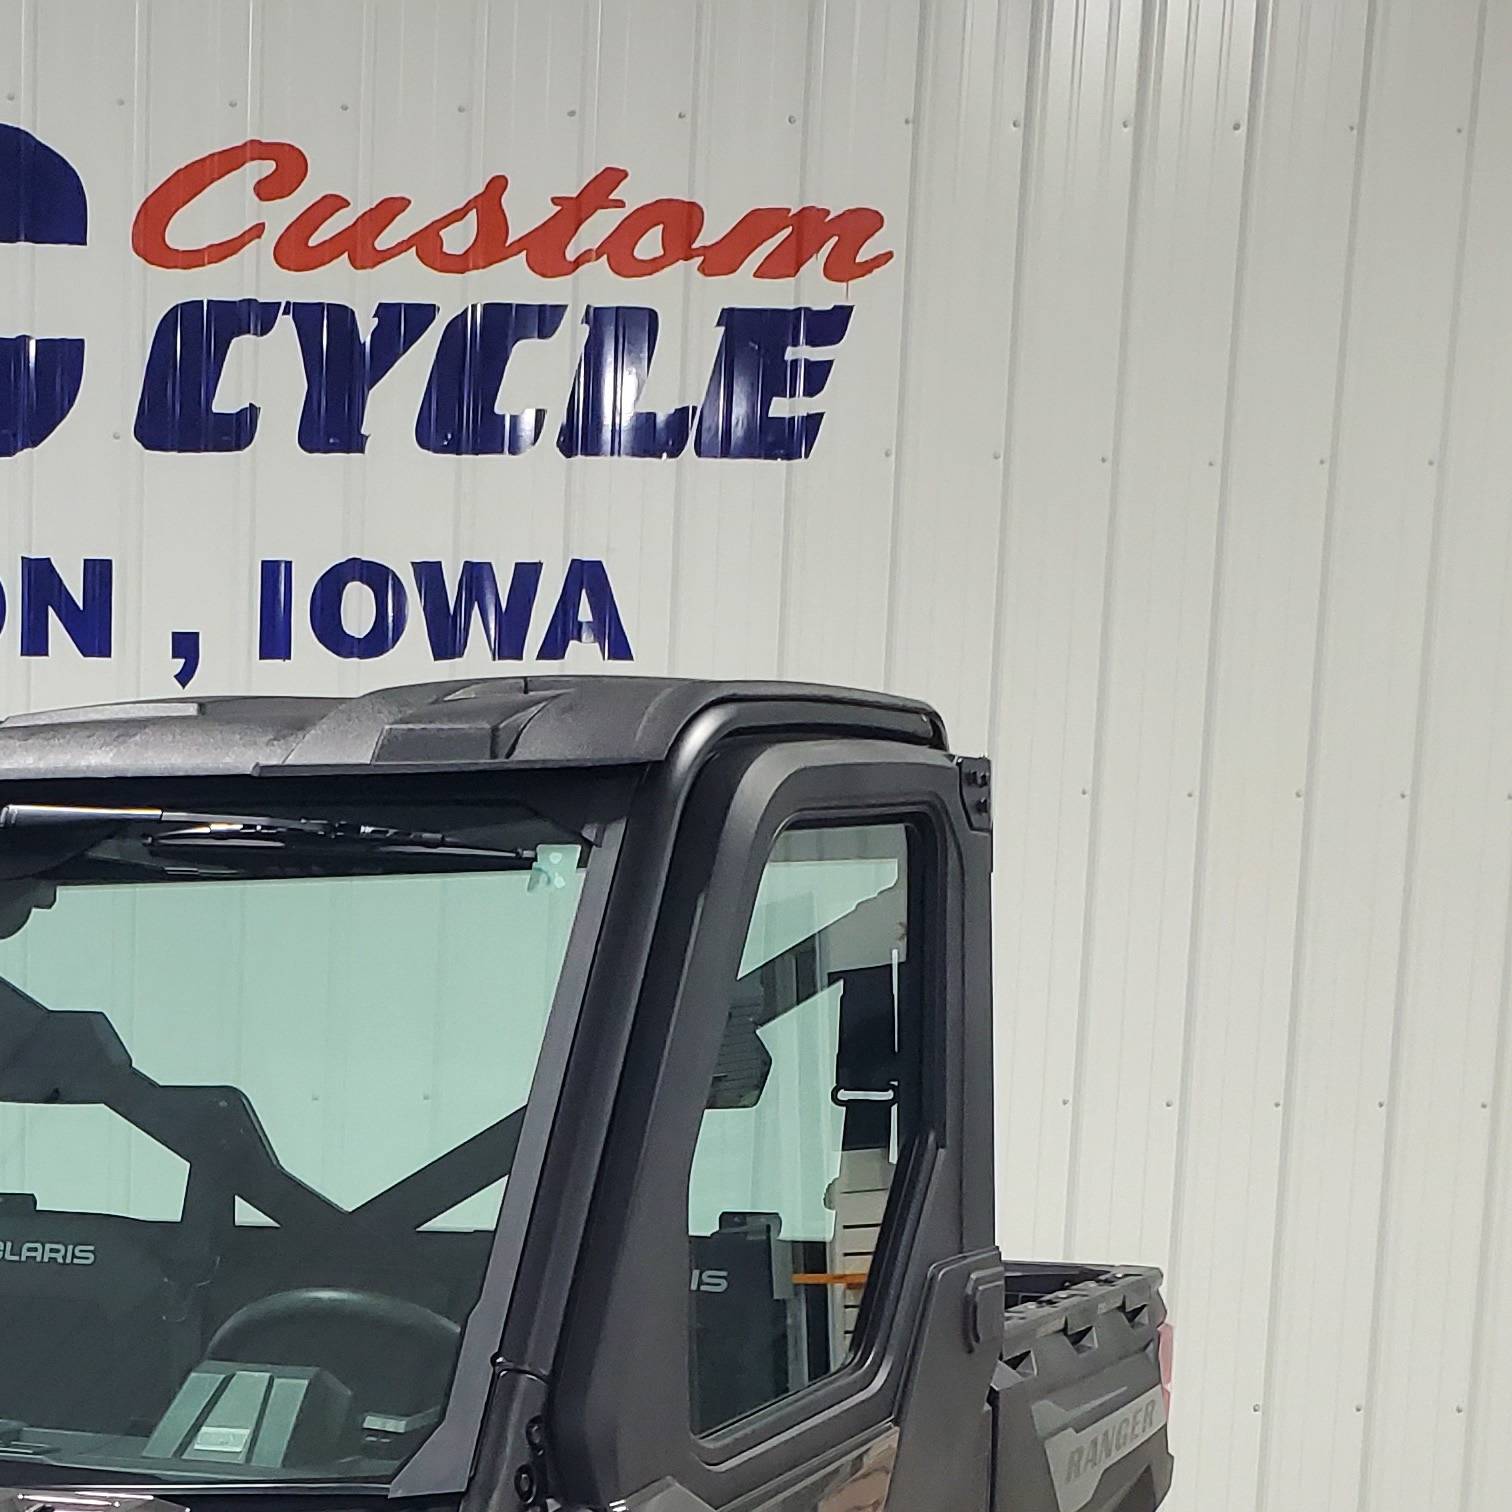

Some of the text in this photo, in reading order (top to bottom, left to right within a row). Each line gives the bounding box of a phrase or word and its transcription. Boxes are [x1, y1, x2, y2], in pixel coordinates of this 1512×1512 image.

[131, 139, 894, 284] Custom
[134, 299, 854, 460] CYCLE
[259, 558, 634, 661] IOWA
[1066, 1399, 1156, 1482] RANGER
